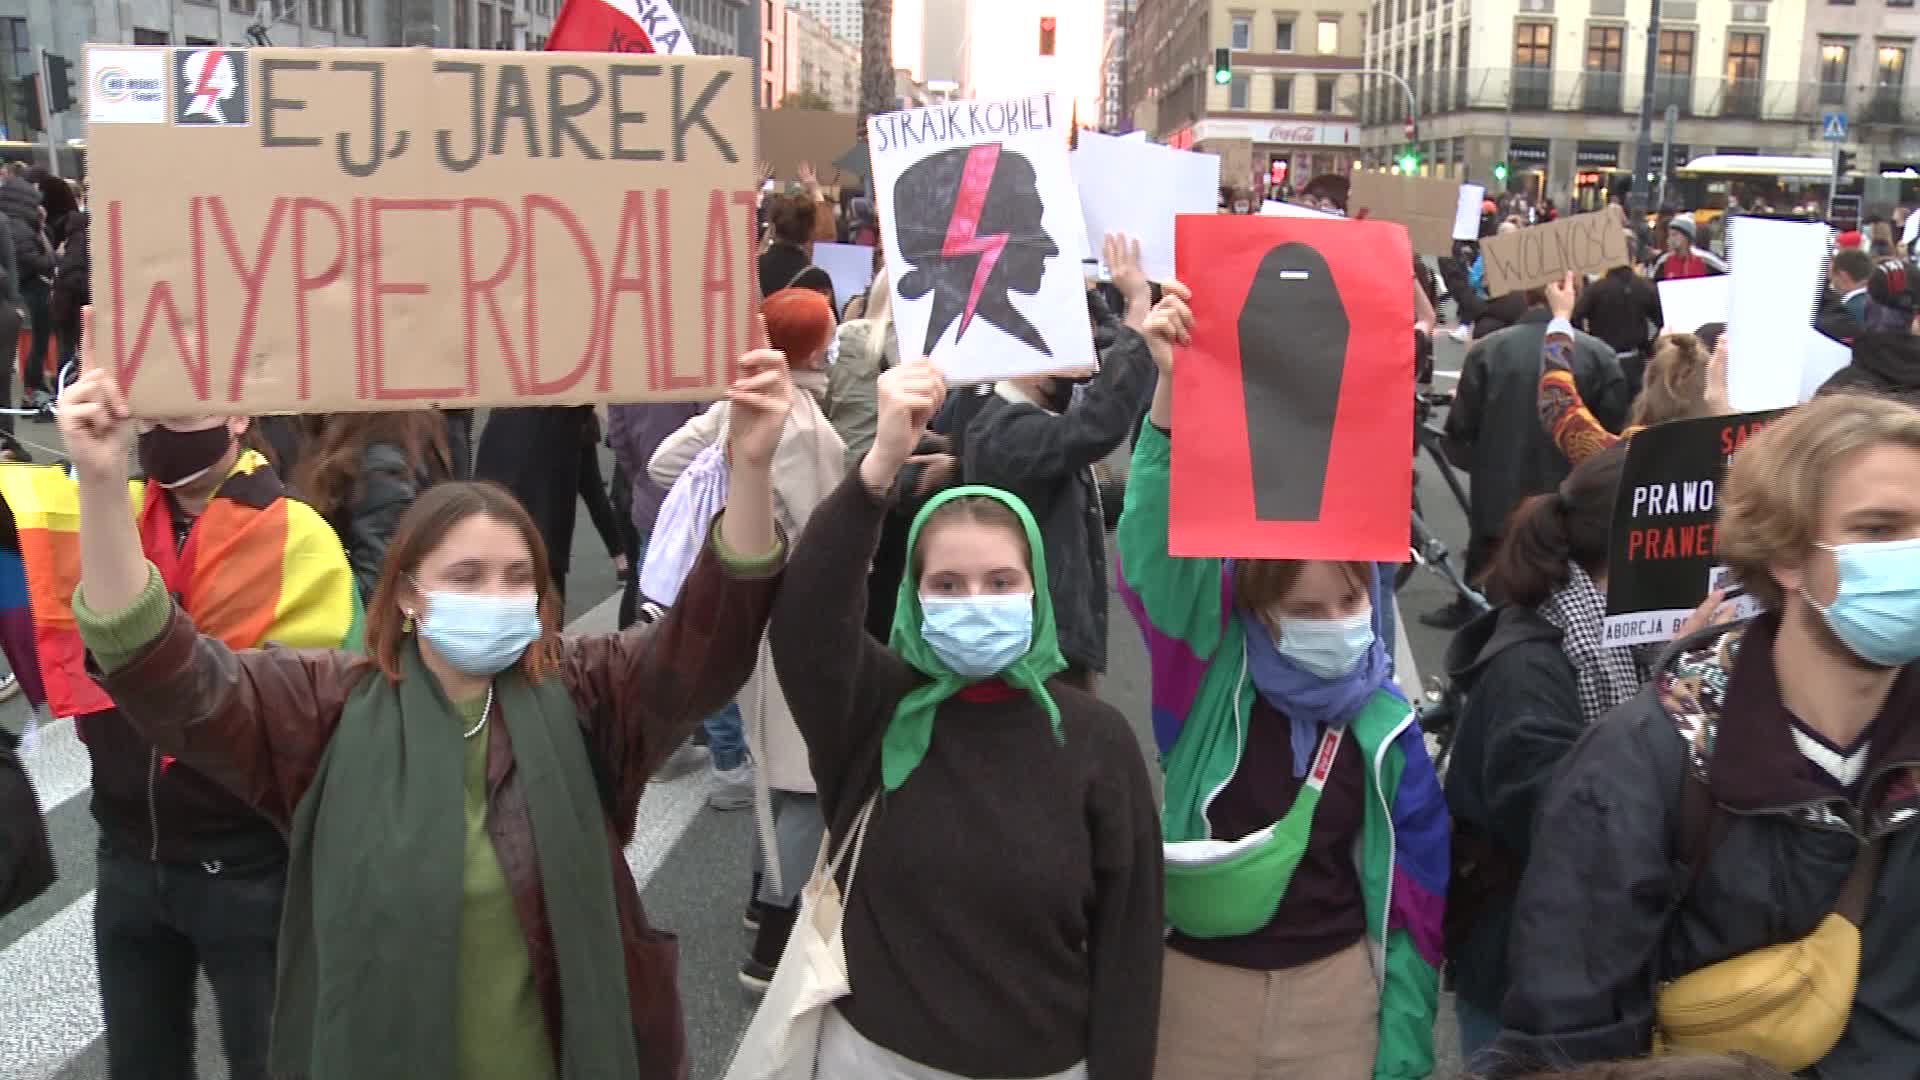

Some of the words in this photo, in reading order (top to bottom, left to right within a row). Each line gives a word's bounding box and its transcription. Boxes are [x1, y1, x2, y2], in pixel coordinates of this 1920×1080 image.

[260, 58, 411, 177] EJ,
[432, 61, 740, 172] JAREK
[875, 103, 965, 152] STRAJK
[969, 93, 1056, 136] KOBIET
[1632, 479, 1714, 518] PRAWO
[1606, 619, 1664, 641] ABORCJA
